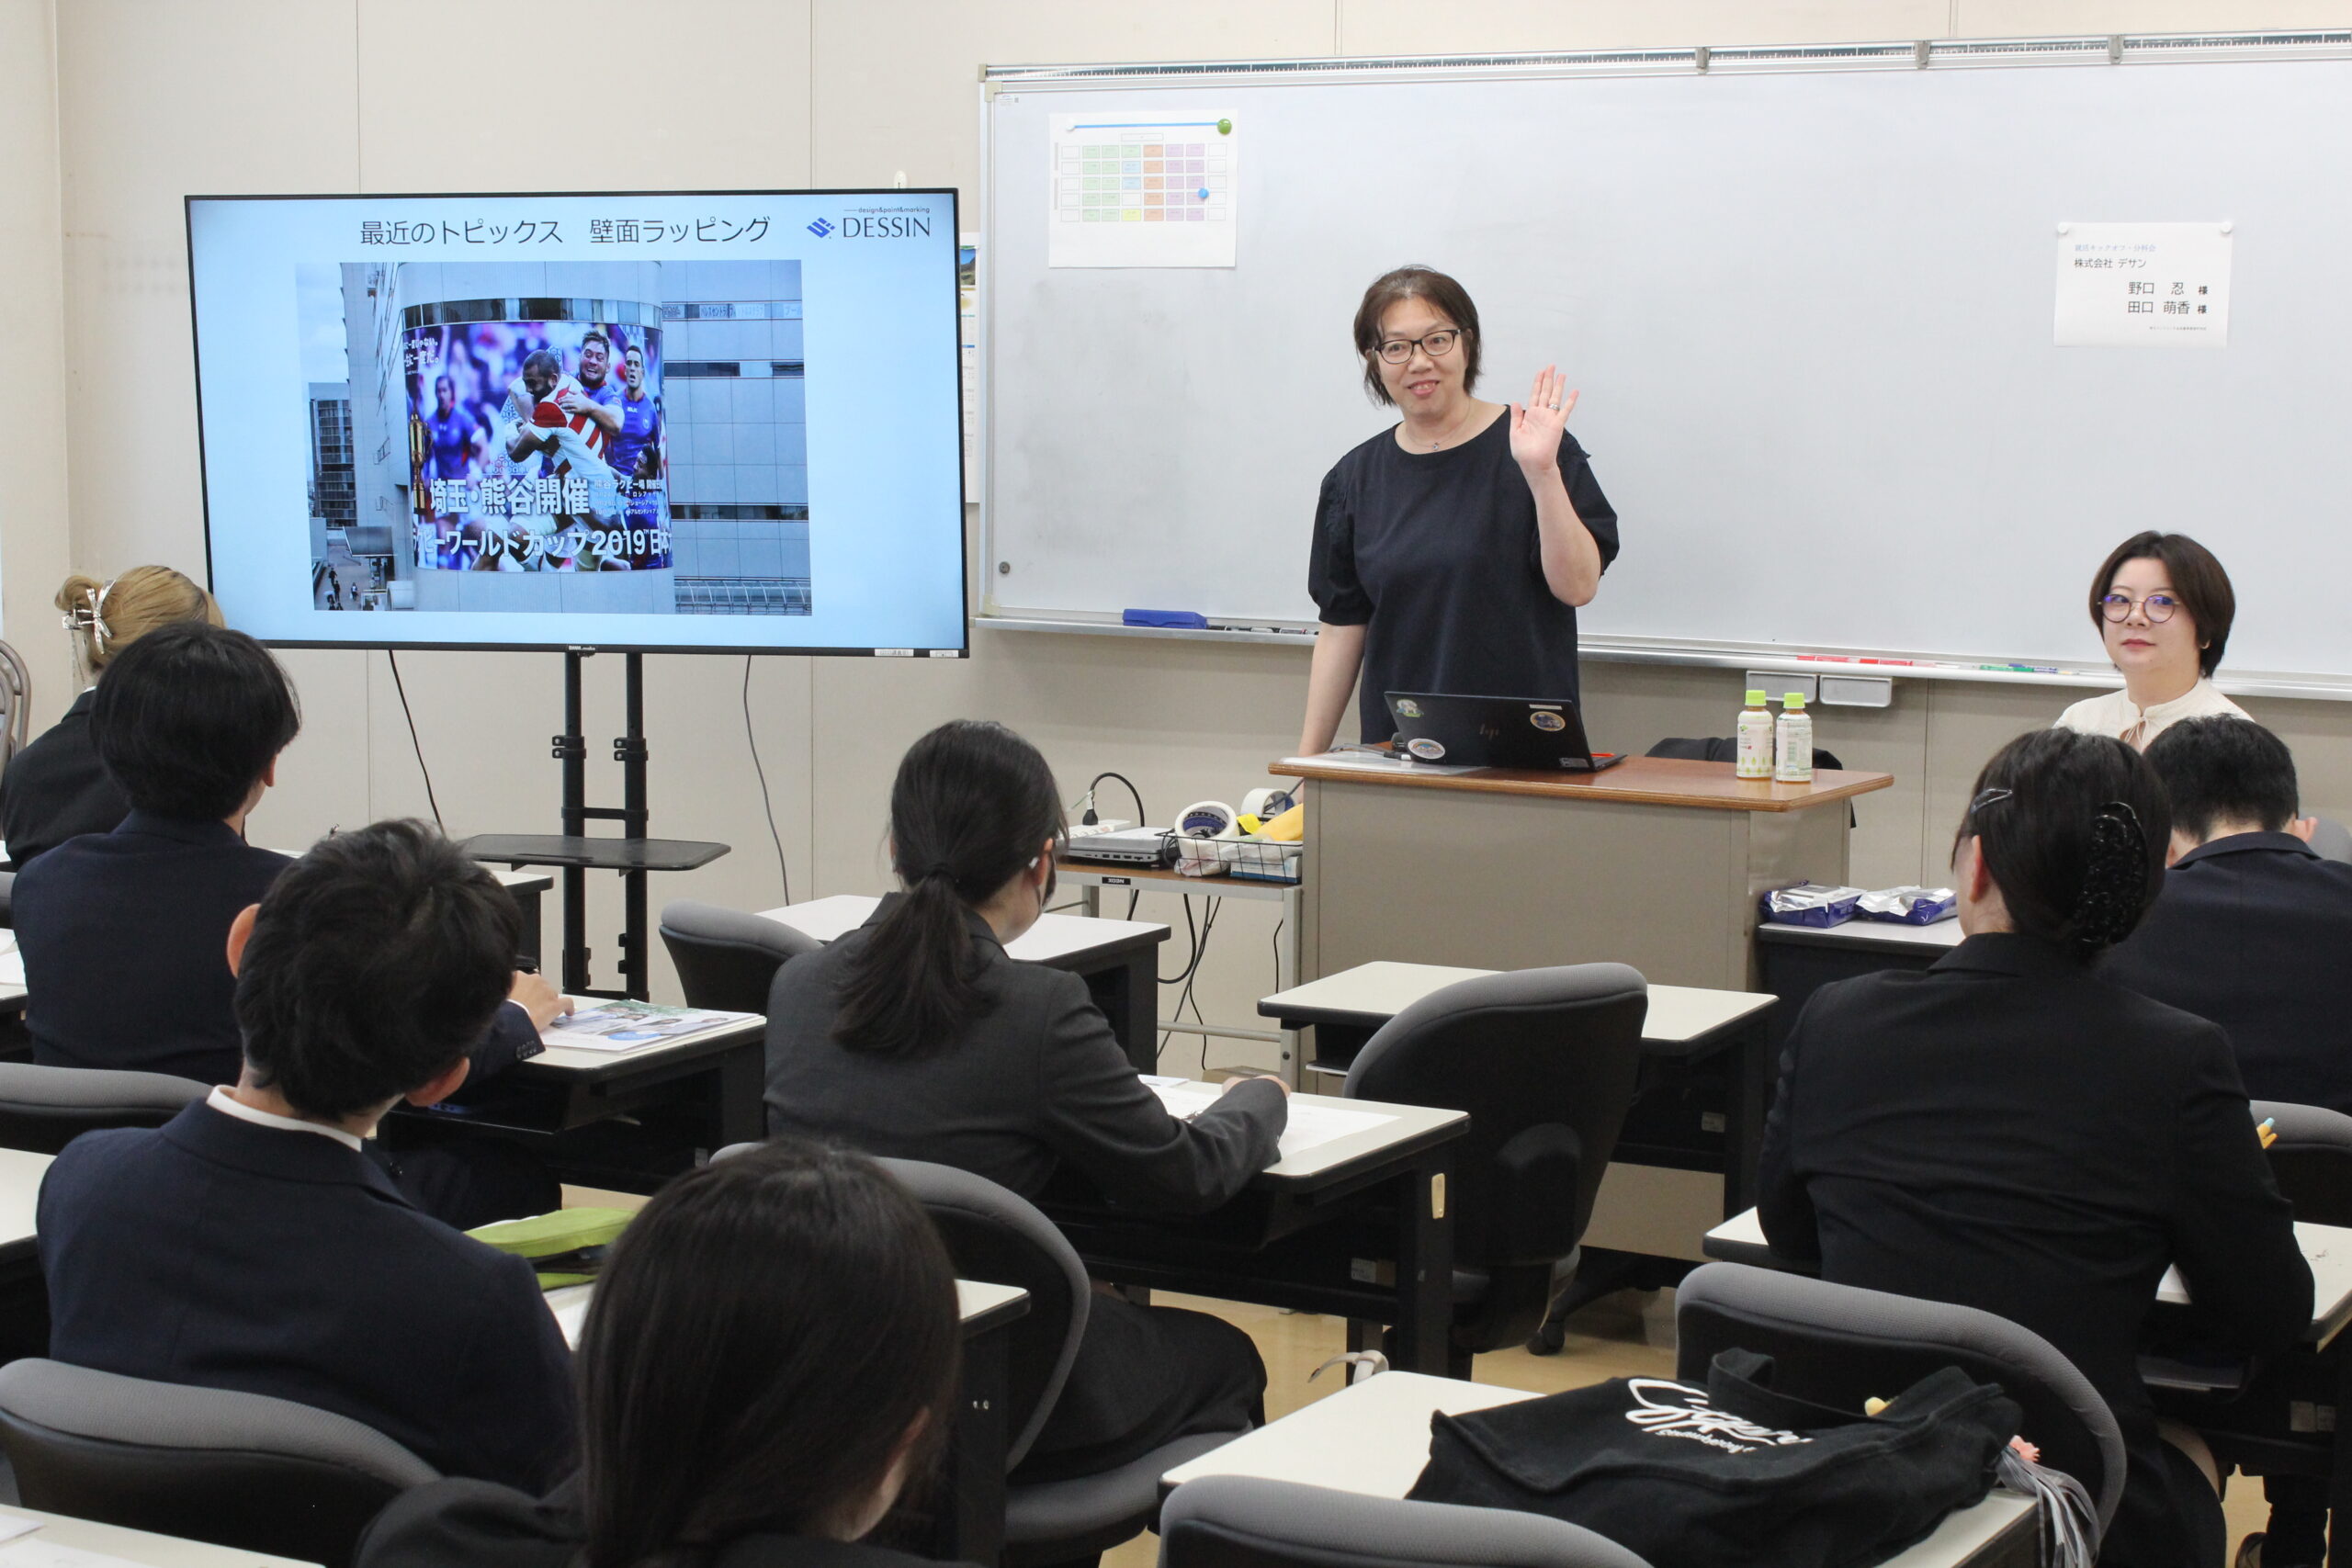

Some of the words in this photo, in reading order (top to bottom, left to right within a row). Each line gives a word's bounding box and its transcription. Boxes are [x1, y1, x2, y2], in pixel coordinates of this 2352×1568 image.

[360, 219, 563, 245] 最近のトピックス
[590, 216, 771, 243] 壁面ラッピング
[842, 217, 931, 238] DESSIN
[2074, 258, 2113, 269] 株式会社
[2118, 258, 2147, 269] デサン
[2128, 281, 2154, 296] 野口
[2171, 282, 2185, 296] 忍
[2127, 300, 2154, 314] 田口
[2164, 300, 2190, 315] 萌香
[430, 477, 591, 516] 埼玉・熊谷開催
